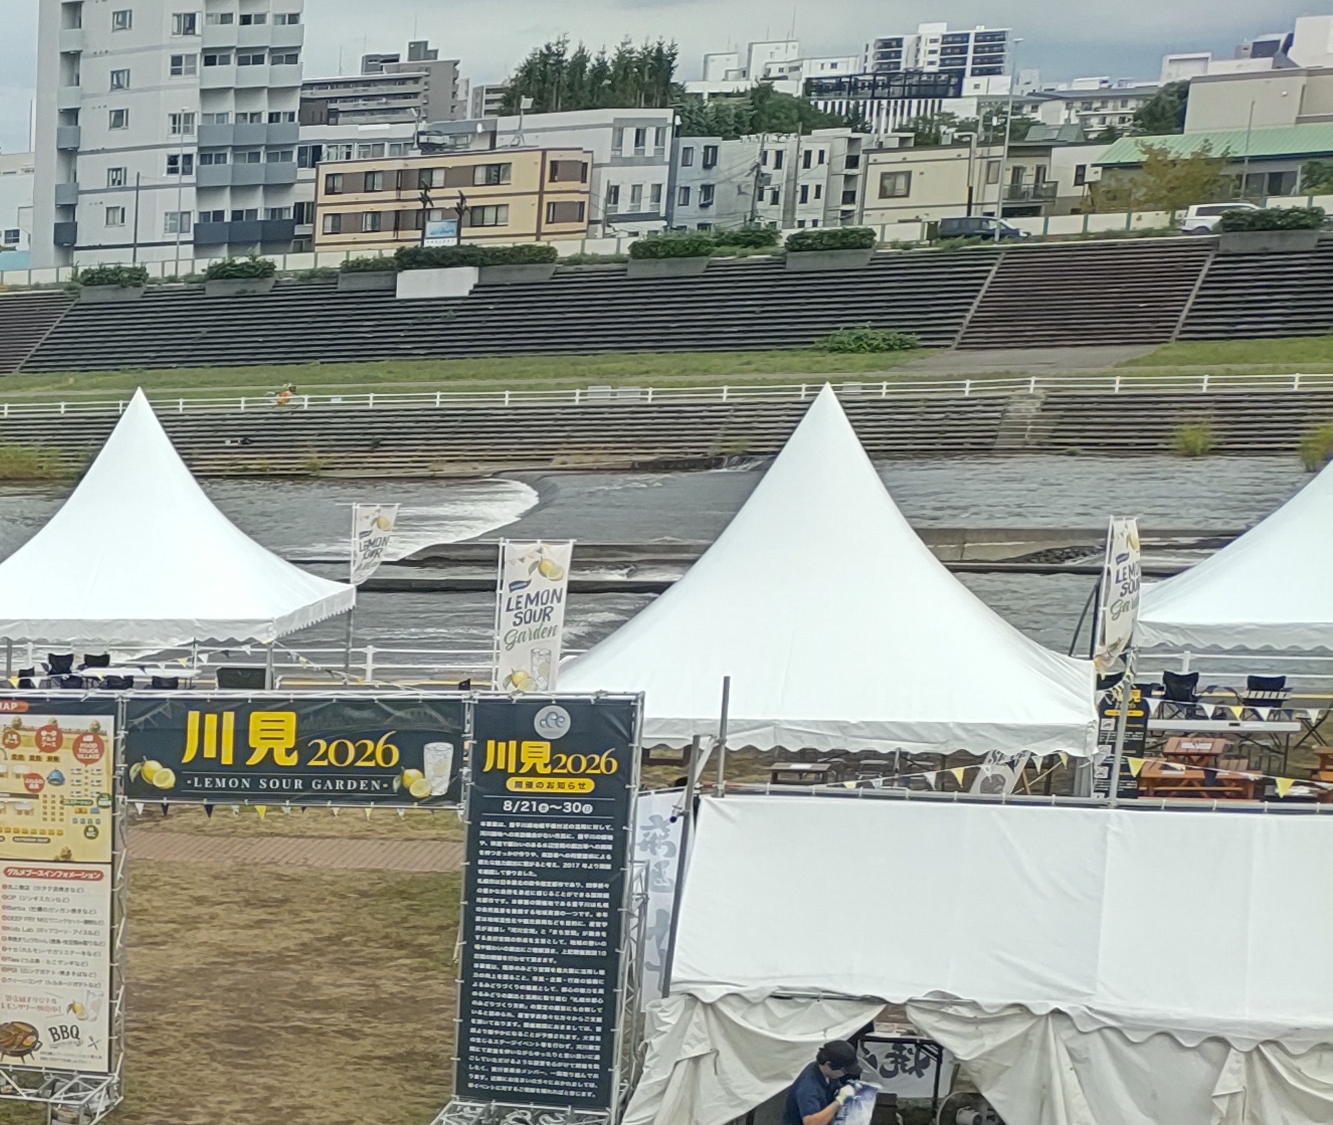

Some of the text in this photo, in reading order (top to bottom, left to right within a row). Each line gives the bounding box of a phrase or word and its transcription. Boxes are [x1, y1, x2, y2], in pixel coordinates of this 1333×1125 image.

[359, 535, 390, 552] LEMON
[1115, 562, 1142, 585] LEM
[505, 587, 563, 613] LEMON
[512, 606, 554, 627] SOUR
[503, 622, 559, 651] Garden
[181, 710, 400, 767] 川見 2026
[483, 740, 618, 775] 川見 2026
[193, 776, 381, 791] LEMON SOUR GARDEN
[514, 780, 586, 790] 開催のお知らせ
[48, 1024, 81, 1043] BBQ
